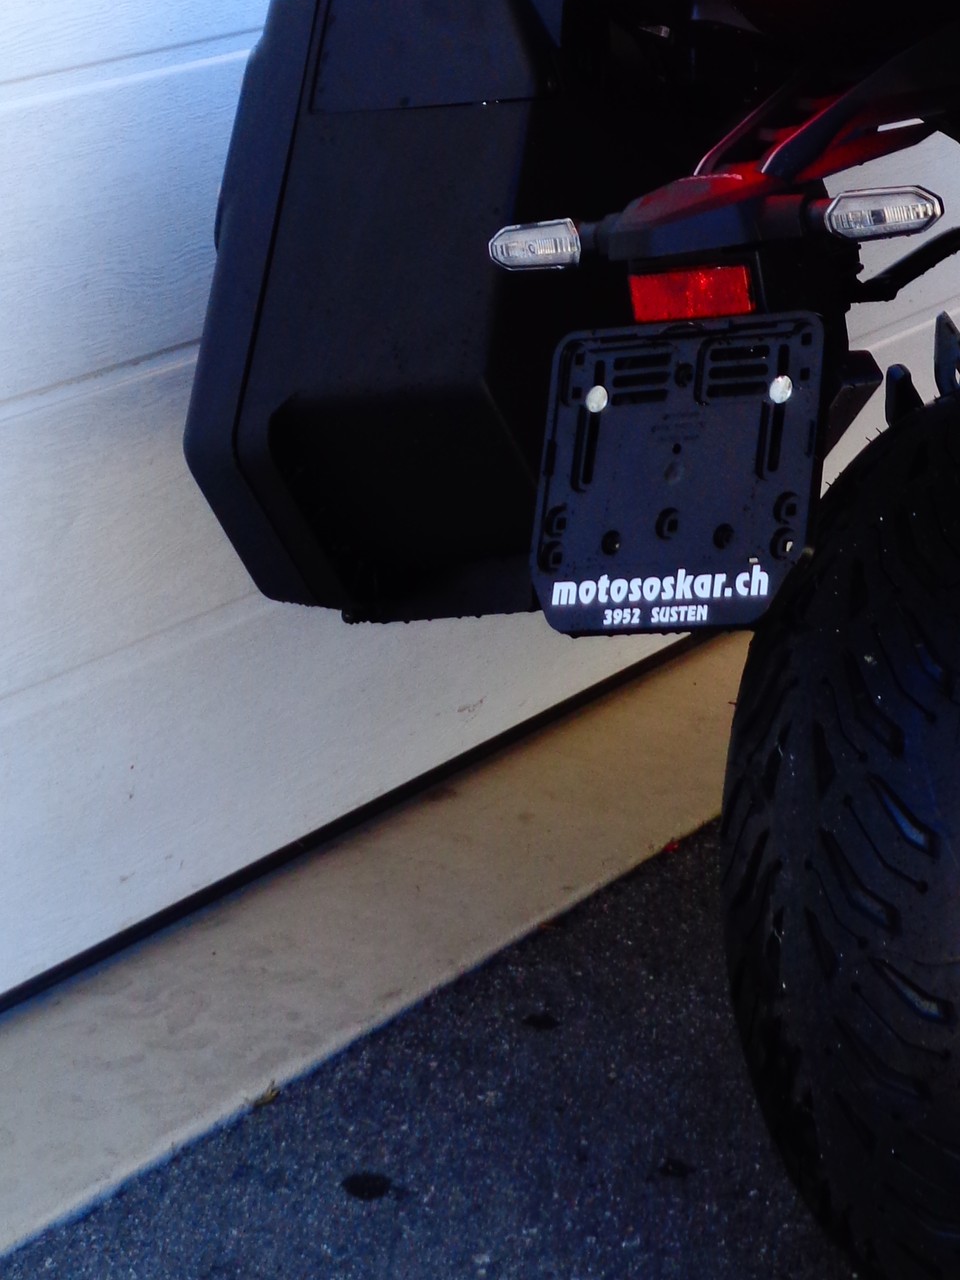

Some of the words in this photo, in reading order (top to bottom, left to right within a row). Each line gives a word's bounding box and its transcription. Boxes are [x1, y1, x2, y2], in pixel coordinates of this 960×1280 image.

[551, 564, 769, 606] motososkar.ch
[603, 606, 641, 625] 3952
[651, 604, 708, 623] SUSTEN
